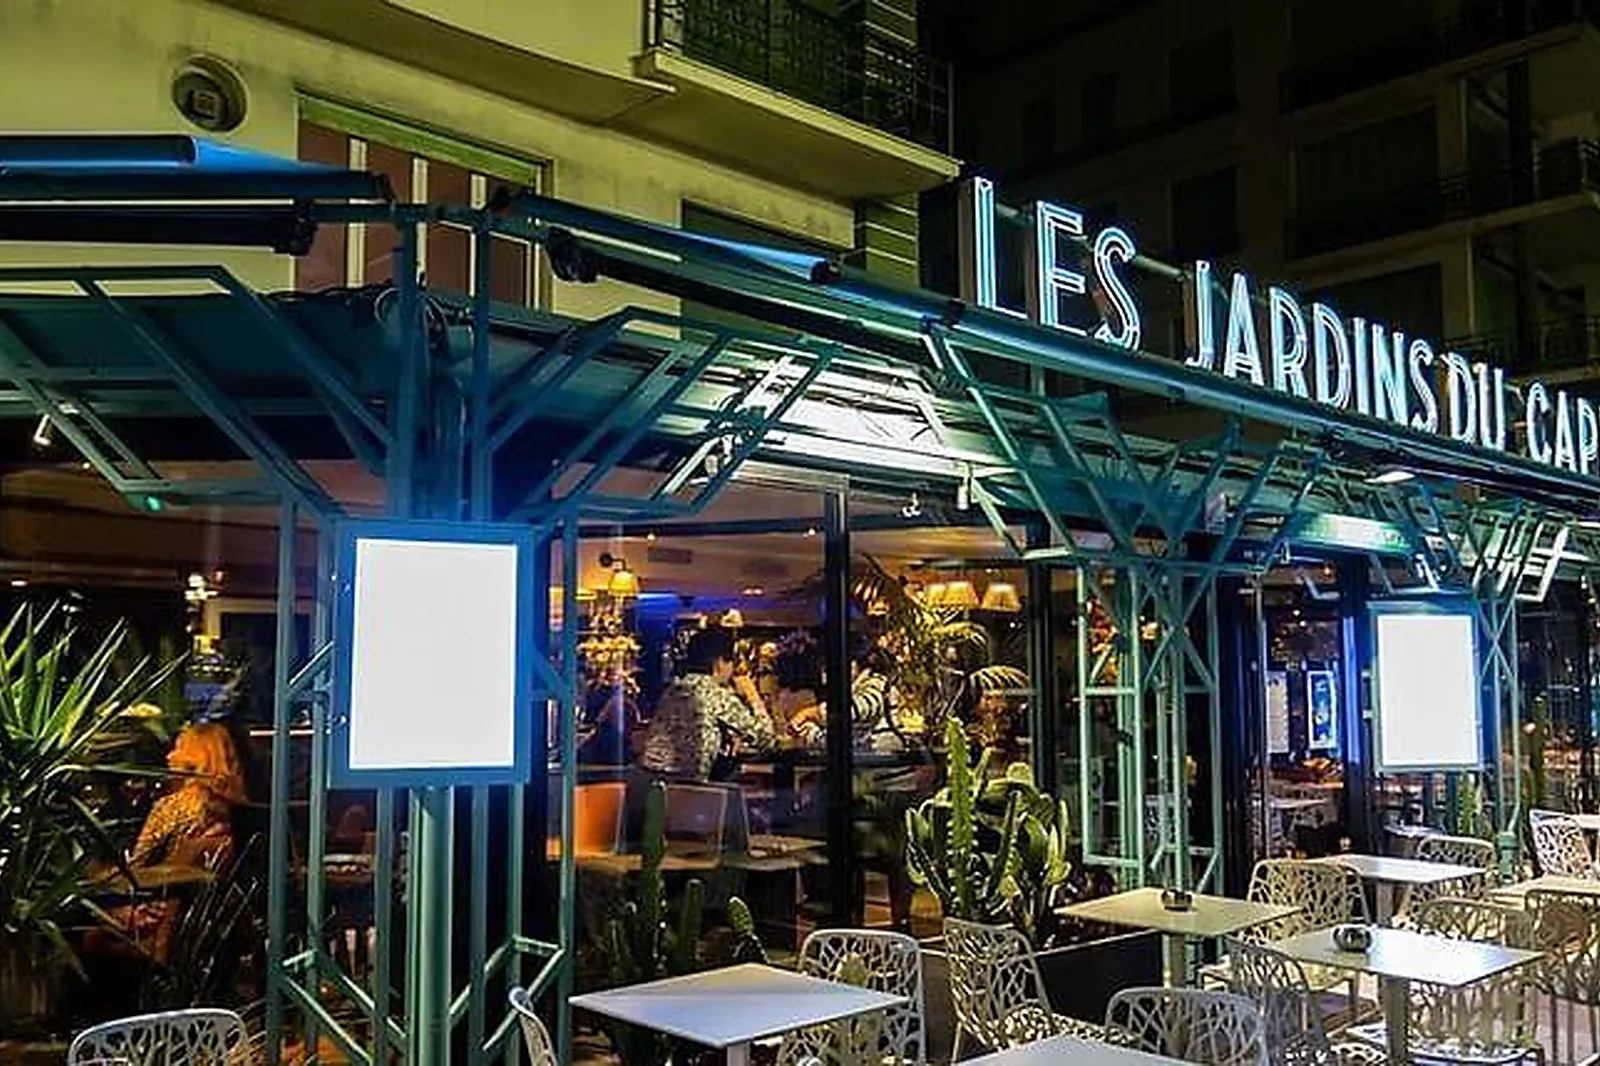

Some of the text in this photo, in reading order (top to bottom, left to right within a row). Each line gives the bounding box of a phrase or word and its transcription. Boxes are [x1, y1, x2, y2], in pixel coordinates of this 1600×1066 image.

[974, 176, 1600, 474] LES JARDINS DU CAP
